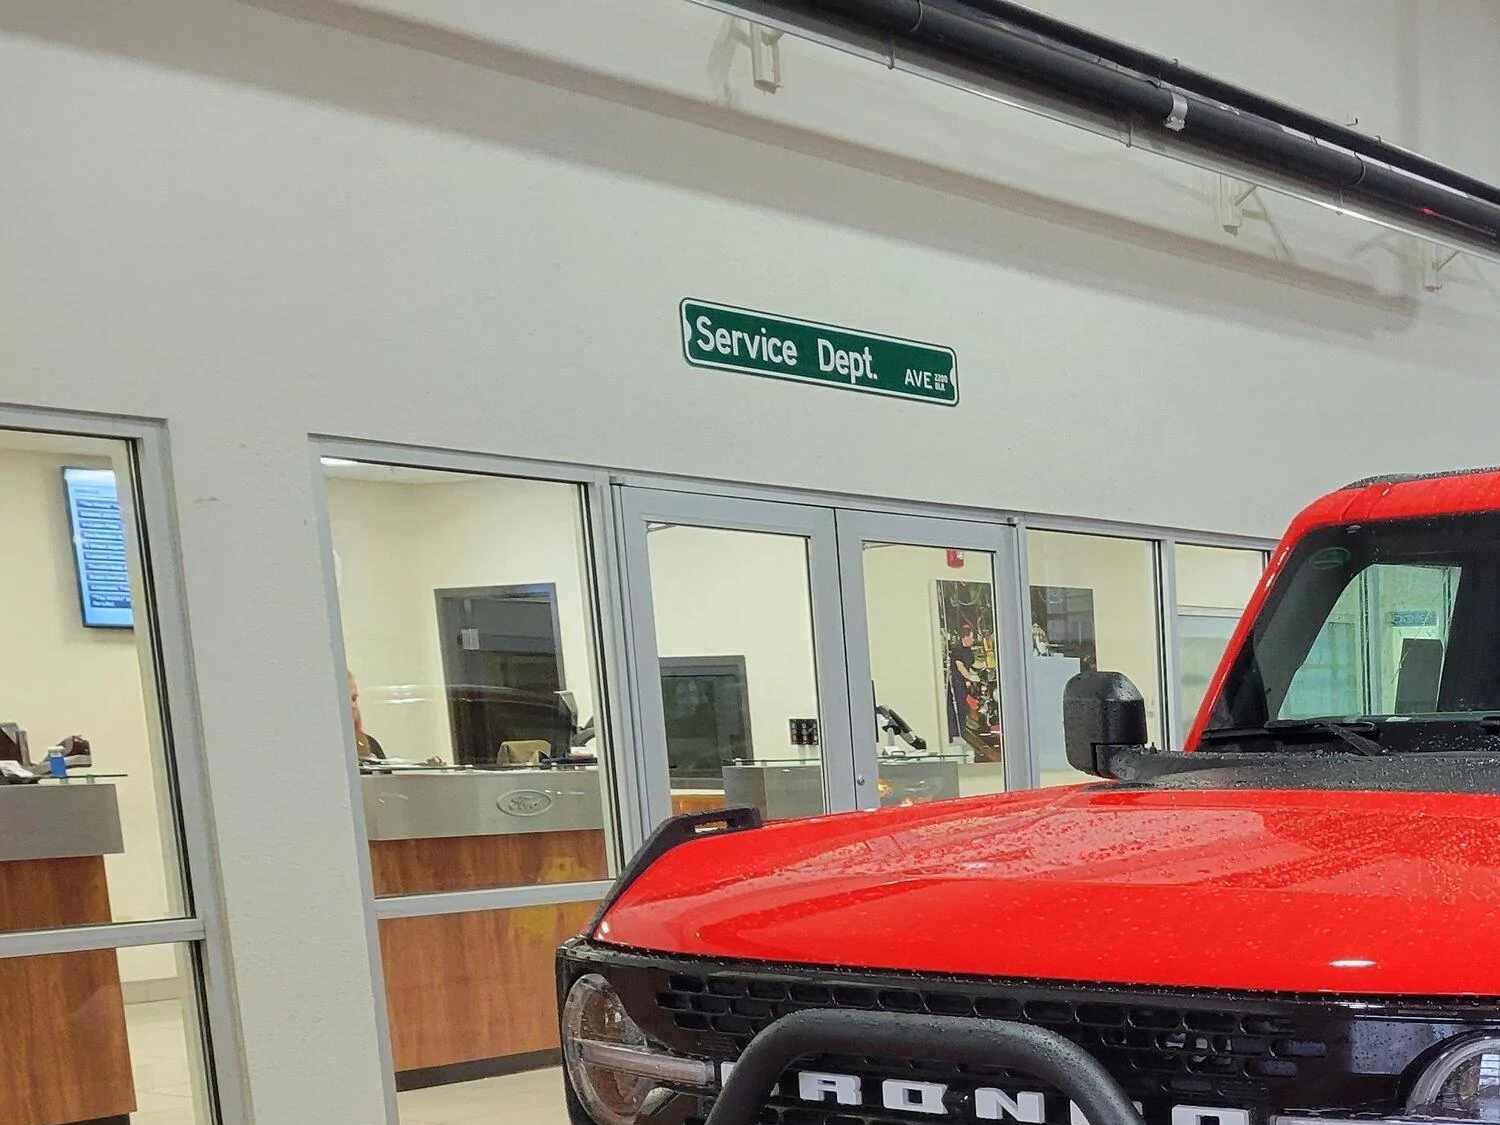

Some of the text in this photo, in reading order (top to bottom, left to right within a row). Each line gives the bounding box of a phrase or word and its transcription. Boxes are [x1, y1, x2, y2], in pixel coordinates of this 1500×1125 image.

[696, 315, 933, 390] Service Dept. AVE
